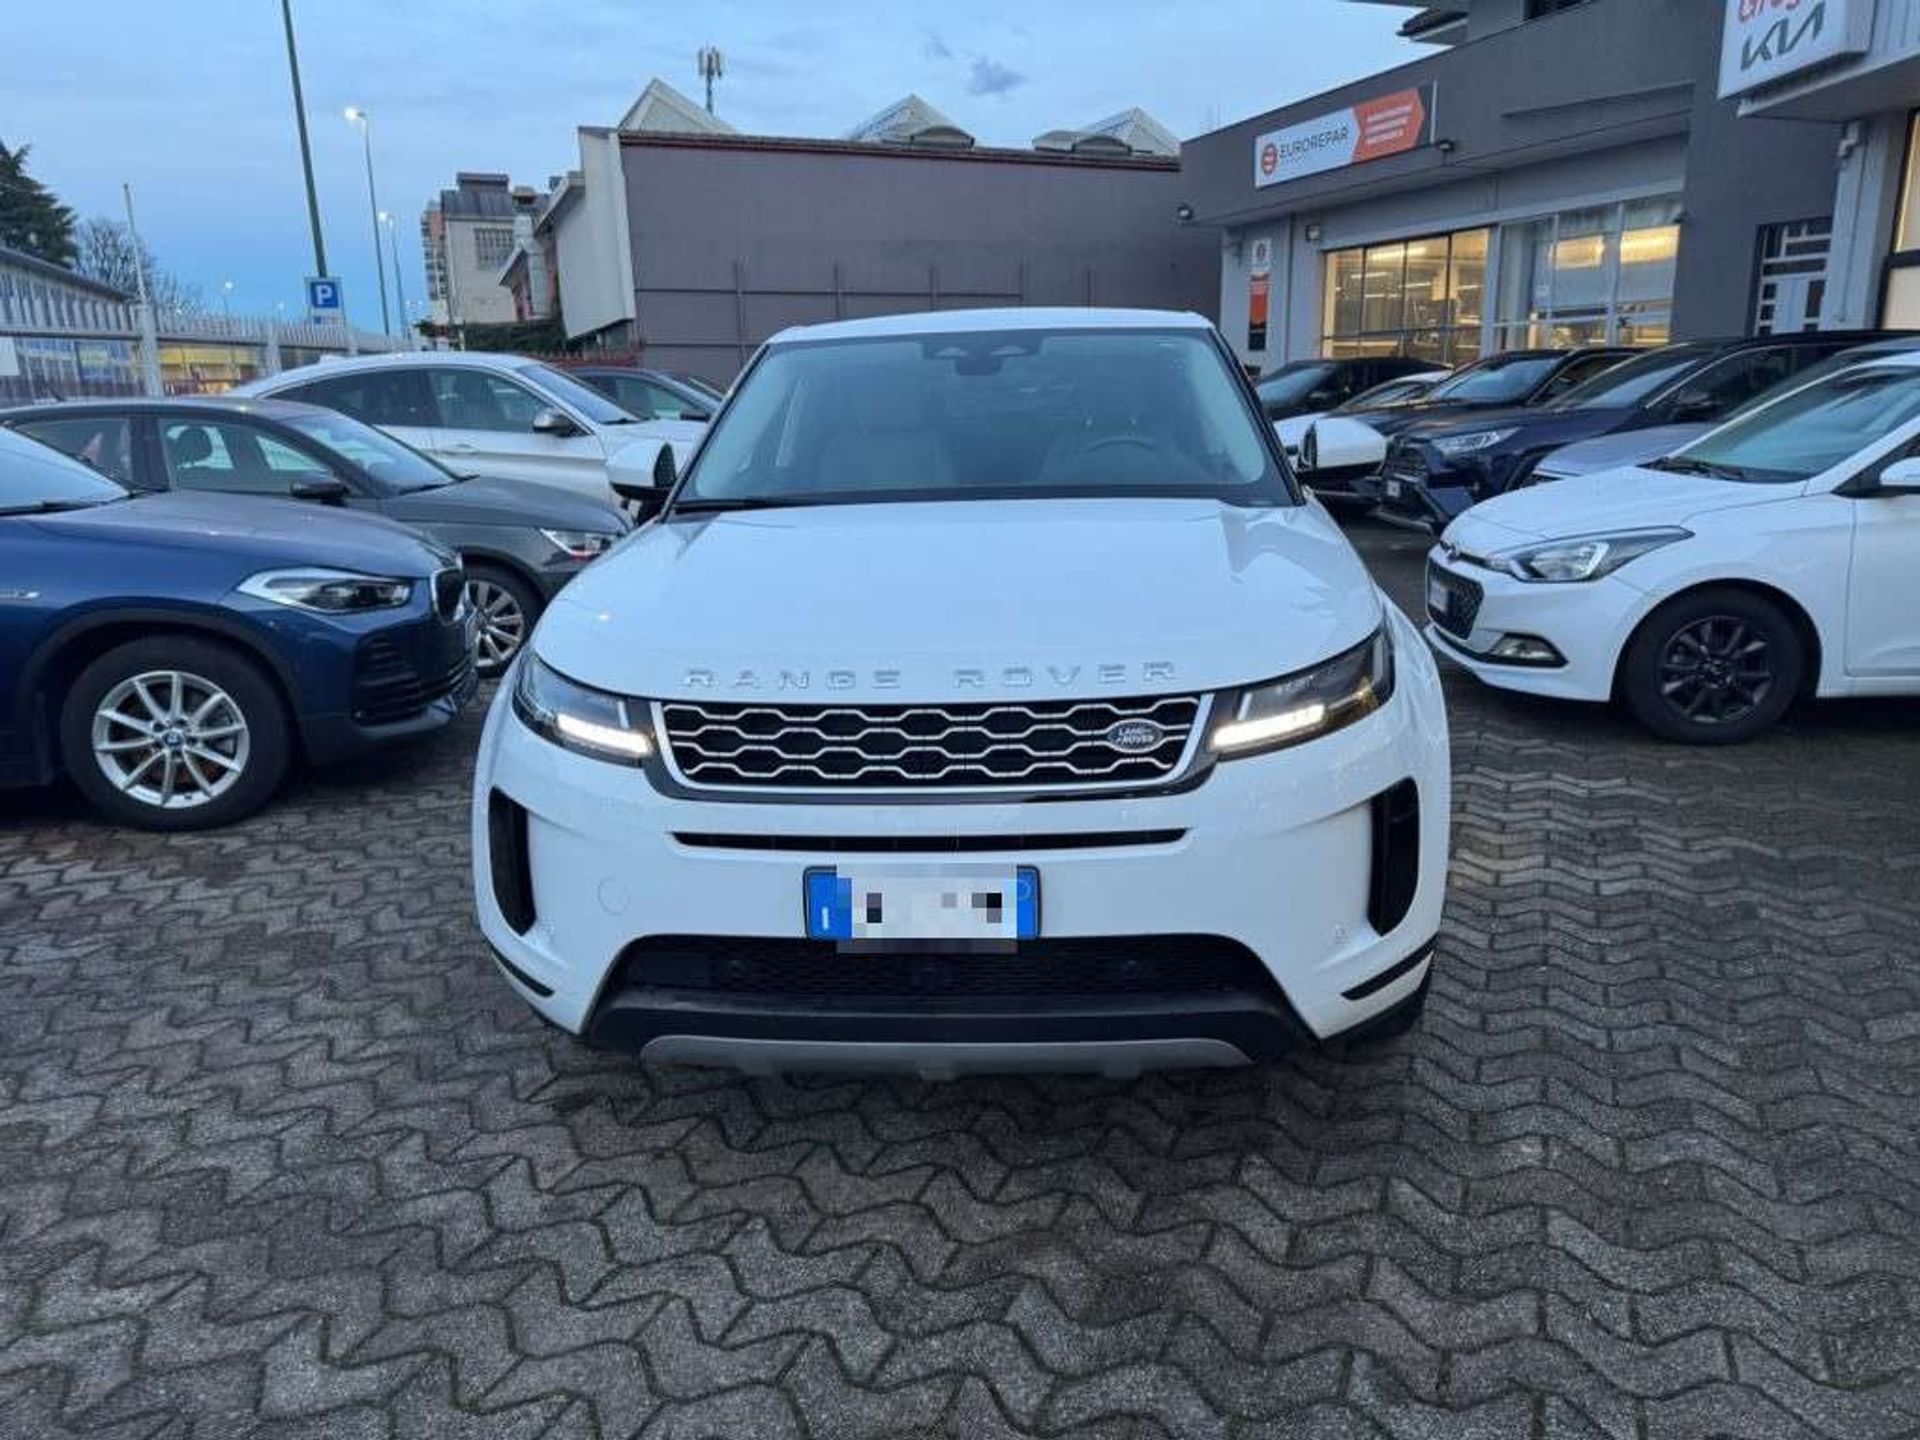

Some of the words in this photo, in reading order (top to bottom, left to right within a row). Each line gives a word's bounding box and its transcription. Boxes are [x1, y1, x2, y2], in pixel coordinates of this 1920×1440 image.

[1279, 126, 1349, 158] EUROREPAR
[316, 285, 333, 305] P
[683, 668, 902, 691] RANGE
[953, 660, 1179, 688] ROVER
